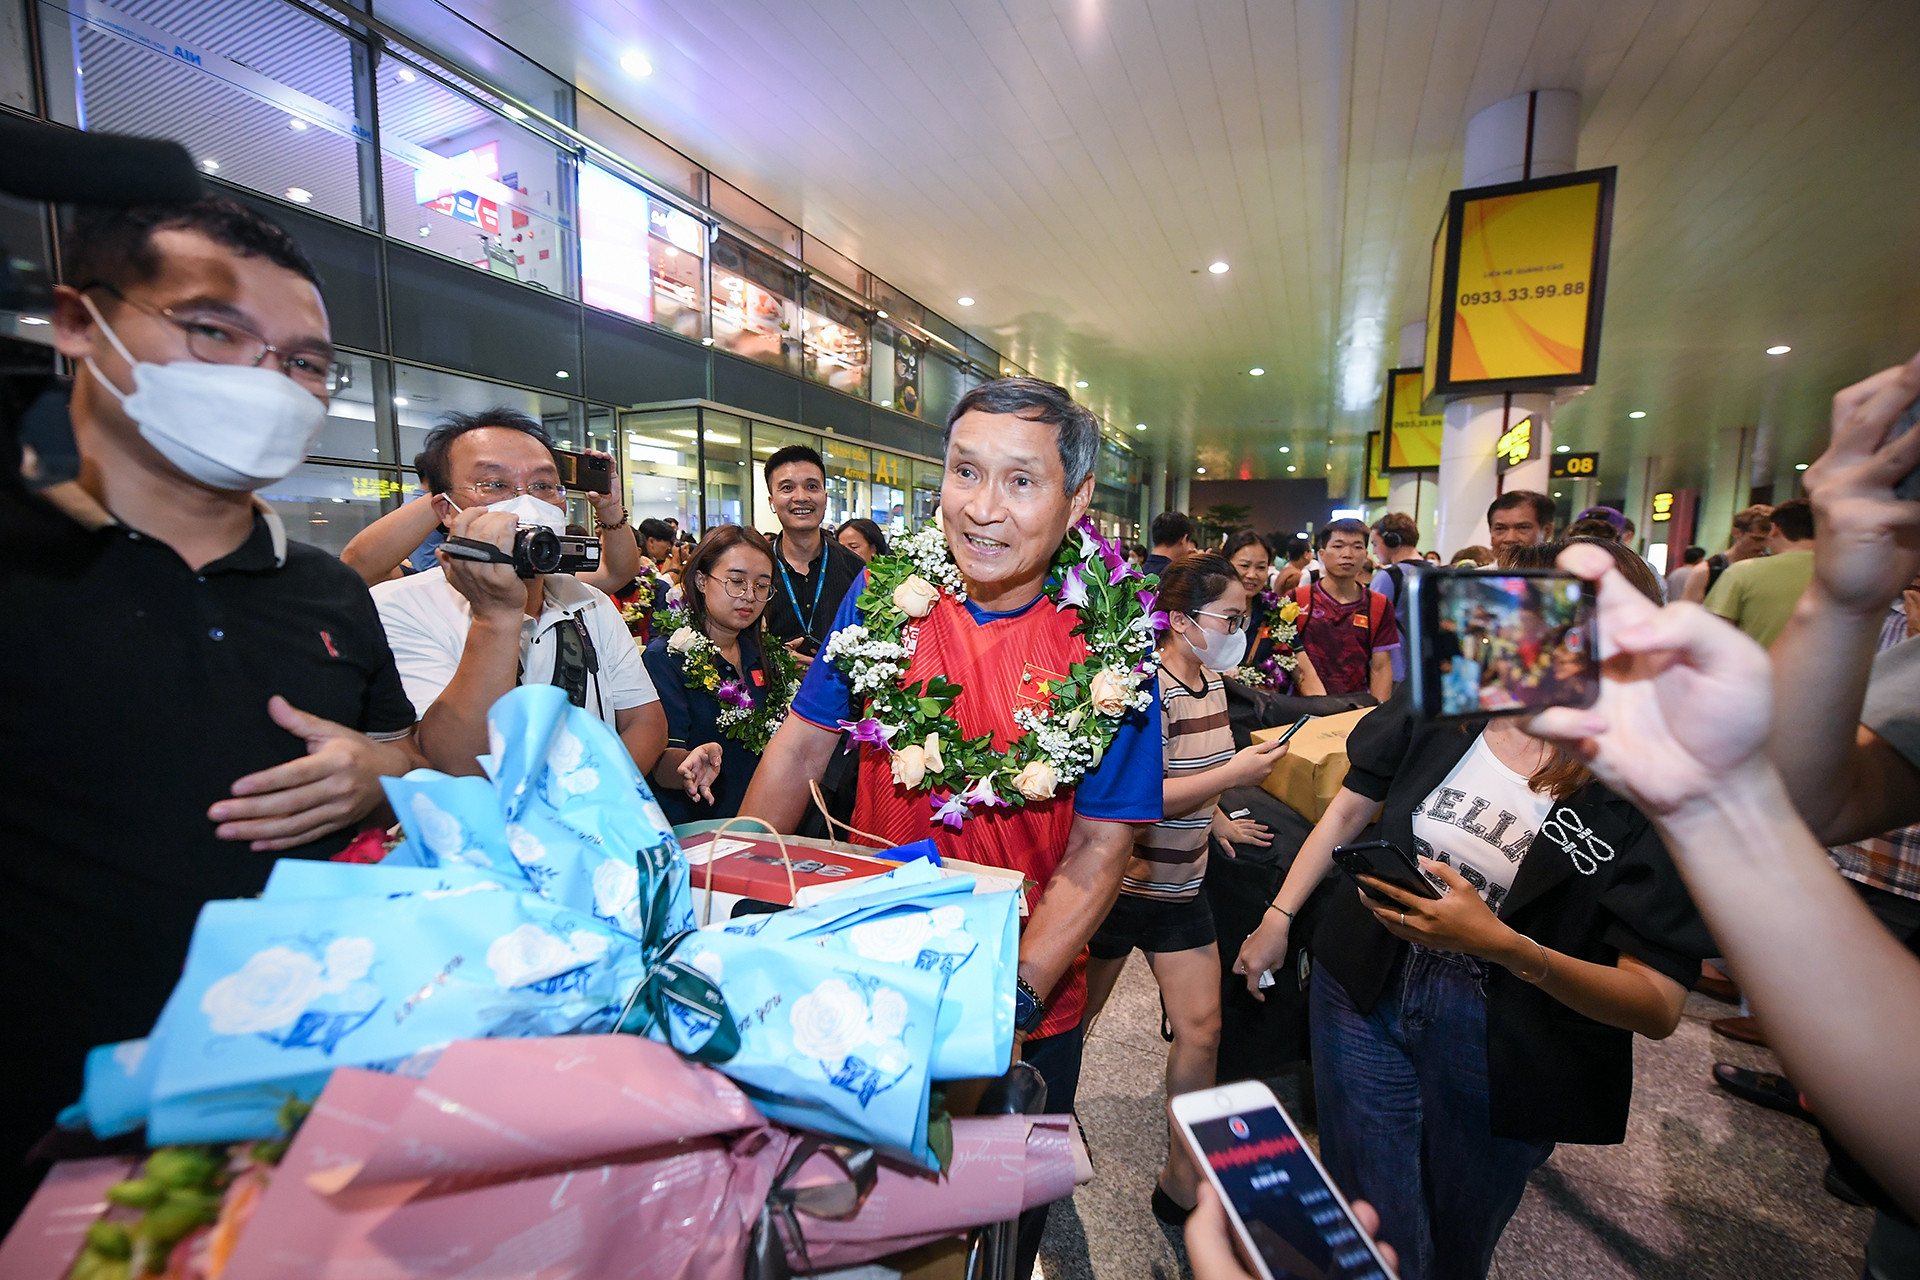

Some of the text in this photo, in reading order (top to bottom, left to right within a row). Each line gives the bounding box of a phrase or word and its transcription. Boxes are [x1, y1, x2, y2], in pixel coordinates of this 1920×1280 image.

[1460, 281, 1585, 306] 0933.33.99.88
[876, 455, 898, 485] A1
[1567, 457, 1594, 473] 08
[1412, 786, 1537, 864] ELIA
